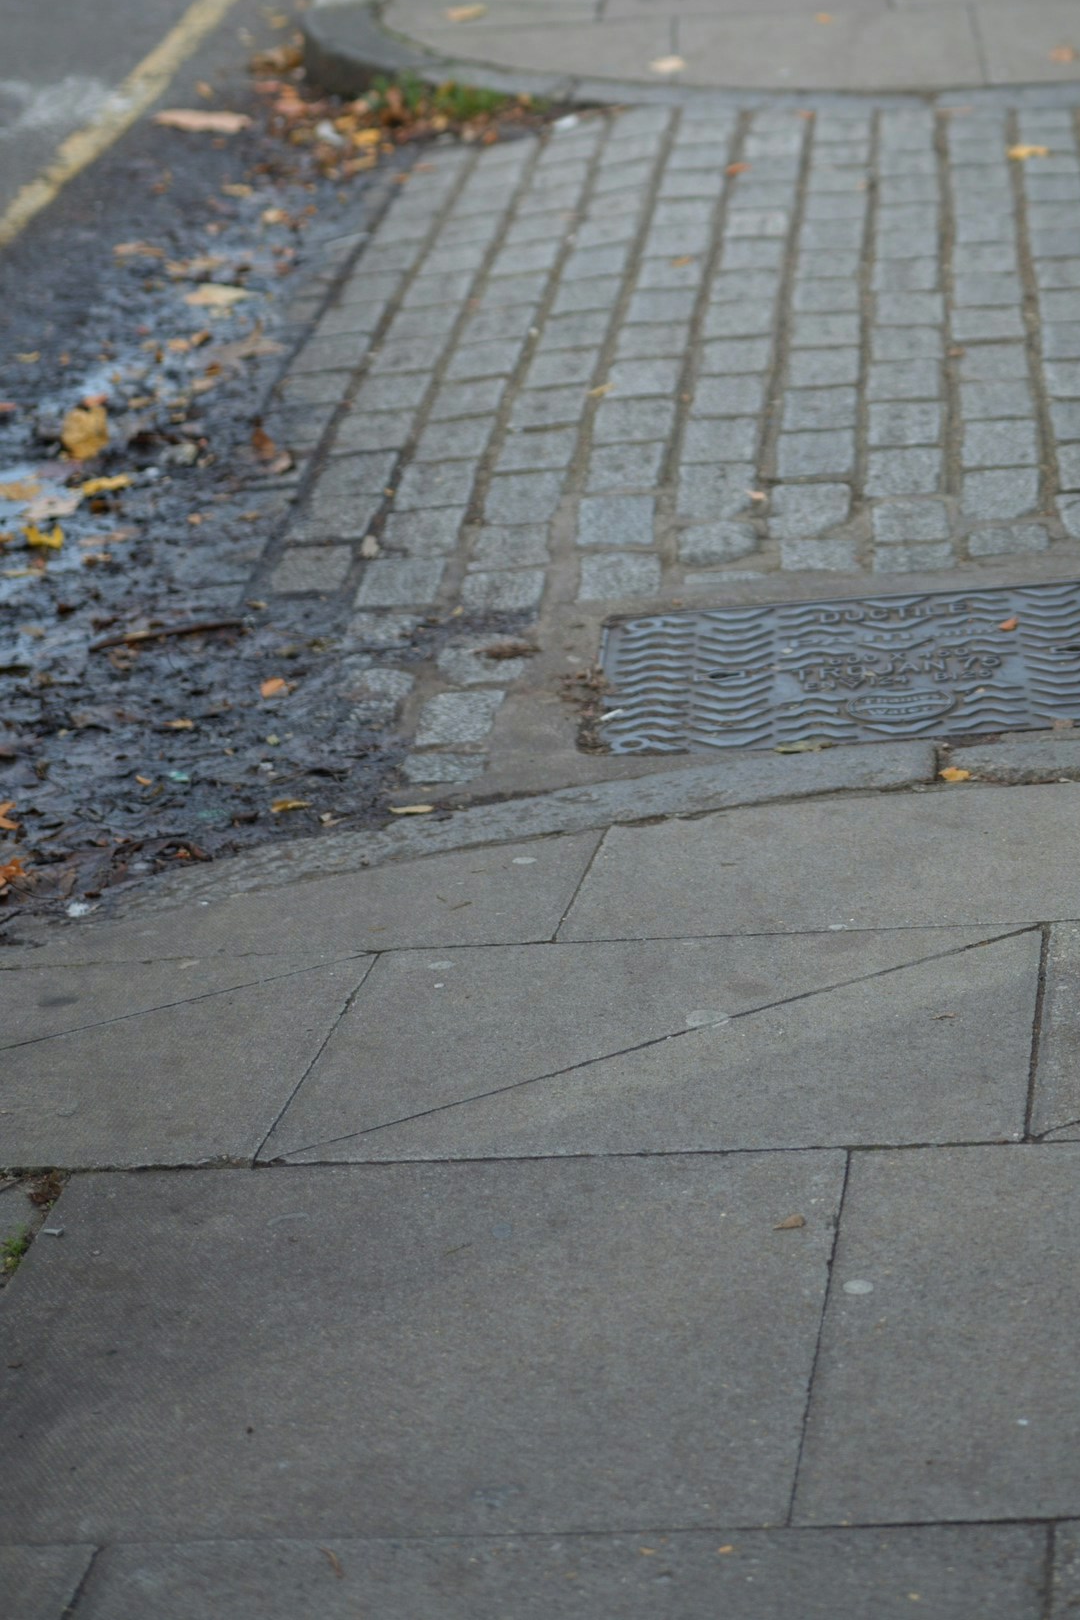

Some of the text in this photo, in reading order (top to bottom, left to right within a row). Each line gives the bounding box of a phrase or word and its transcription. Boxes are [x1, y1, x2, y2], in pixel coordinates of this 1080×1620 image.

[819, 603, 969, 625] DUCTILE
[792, 654, 1000, 681] TROJAN 75
[867, 705, 932, 717] Water
